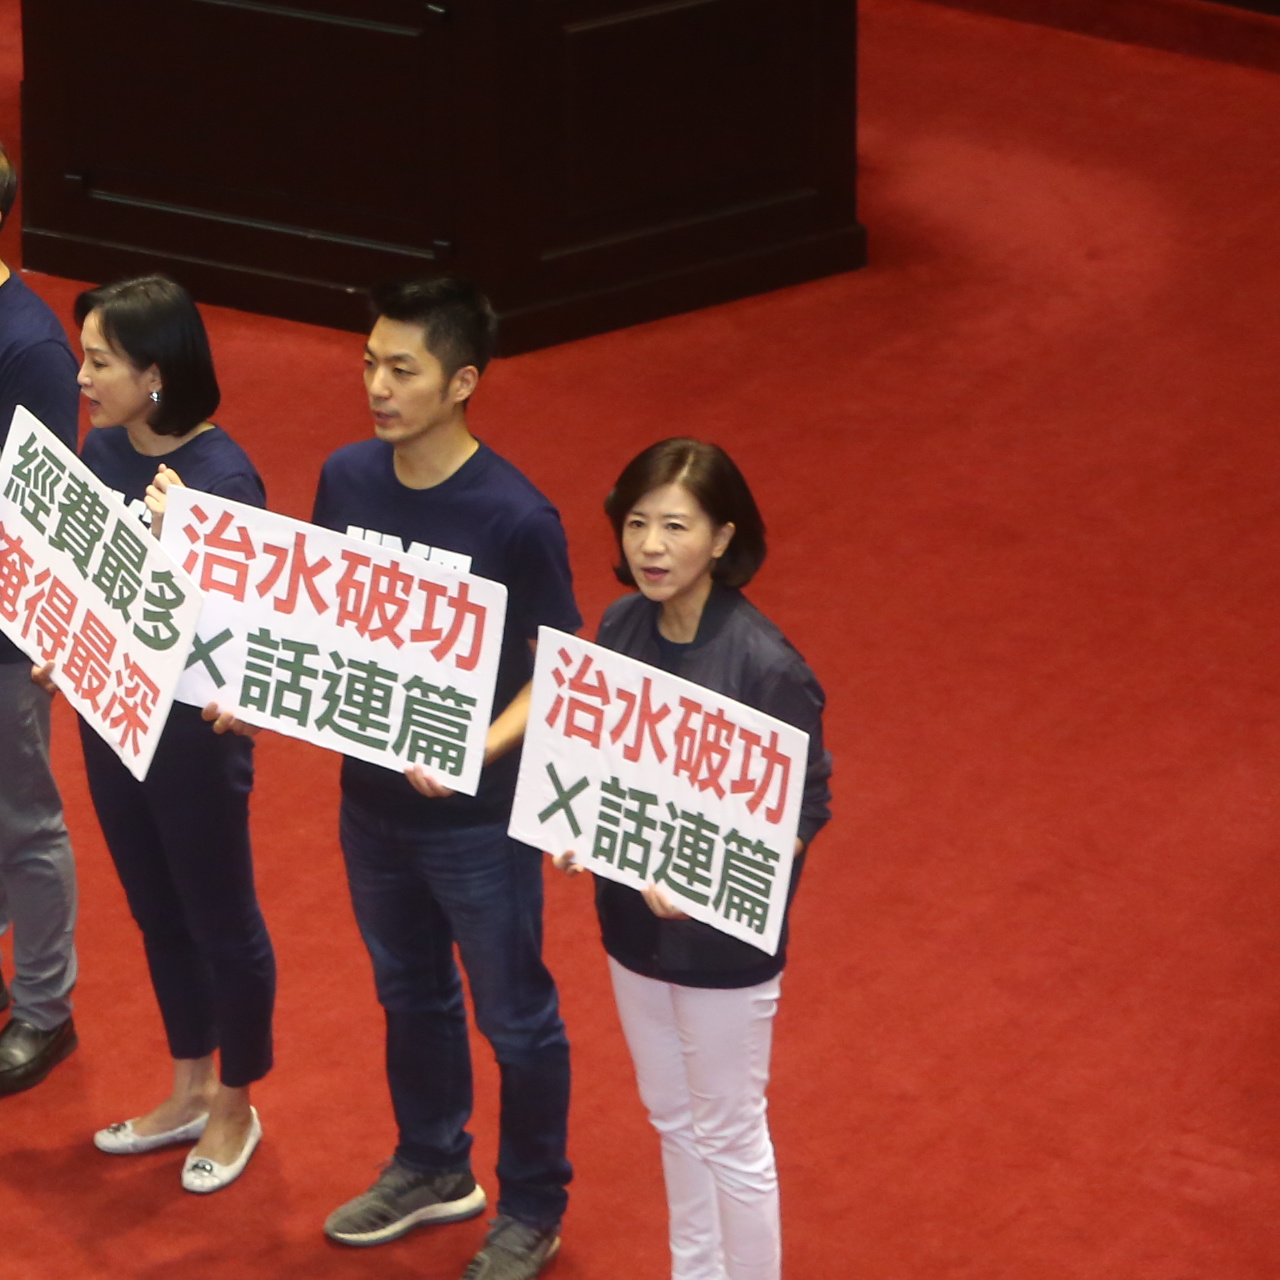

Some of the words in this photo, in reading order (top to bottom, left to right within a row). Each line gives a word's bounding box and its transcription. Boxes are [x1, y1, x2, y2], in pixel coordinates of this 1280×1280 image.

[3, 431, 186, 651] 經費最多
[182, 504, 487, 671] 治水破功
[545, 647, 791, 825] 治水破功
